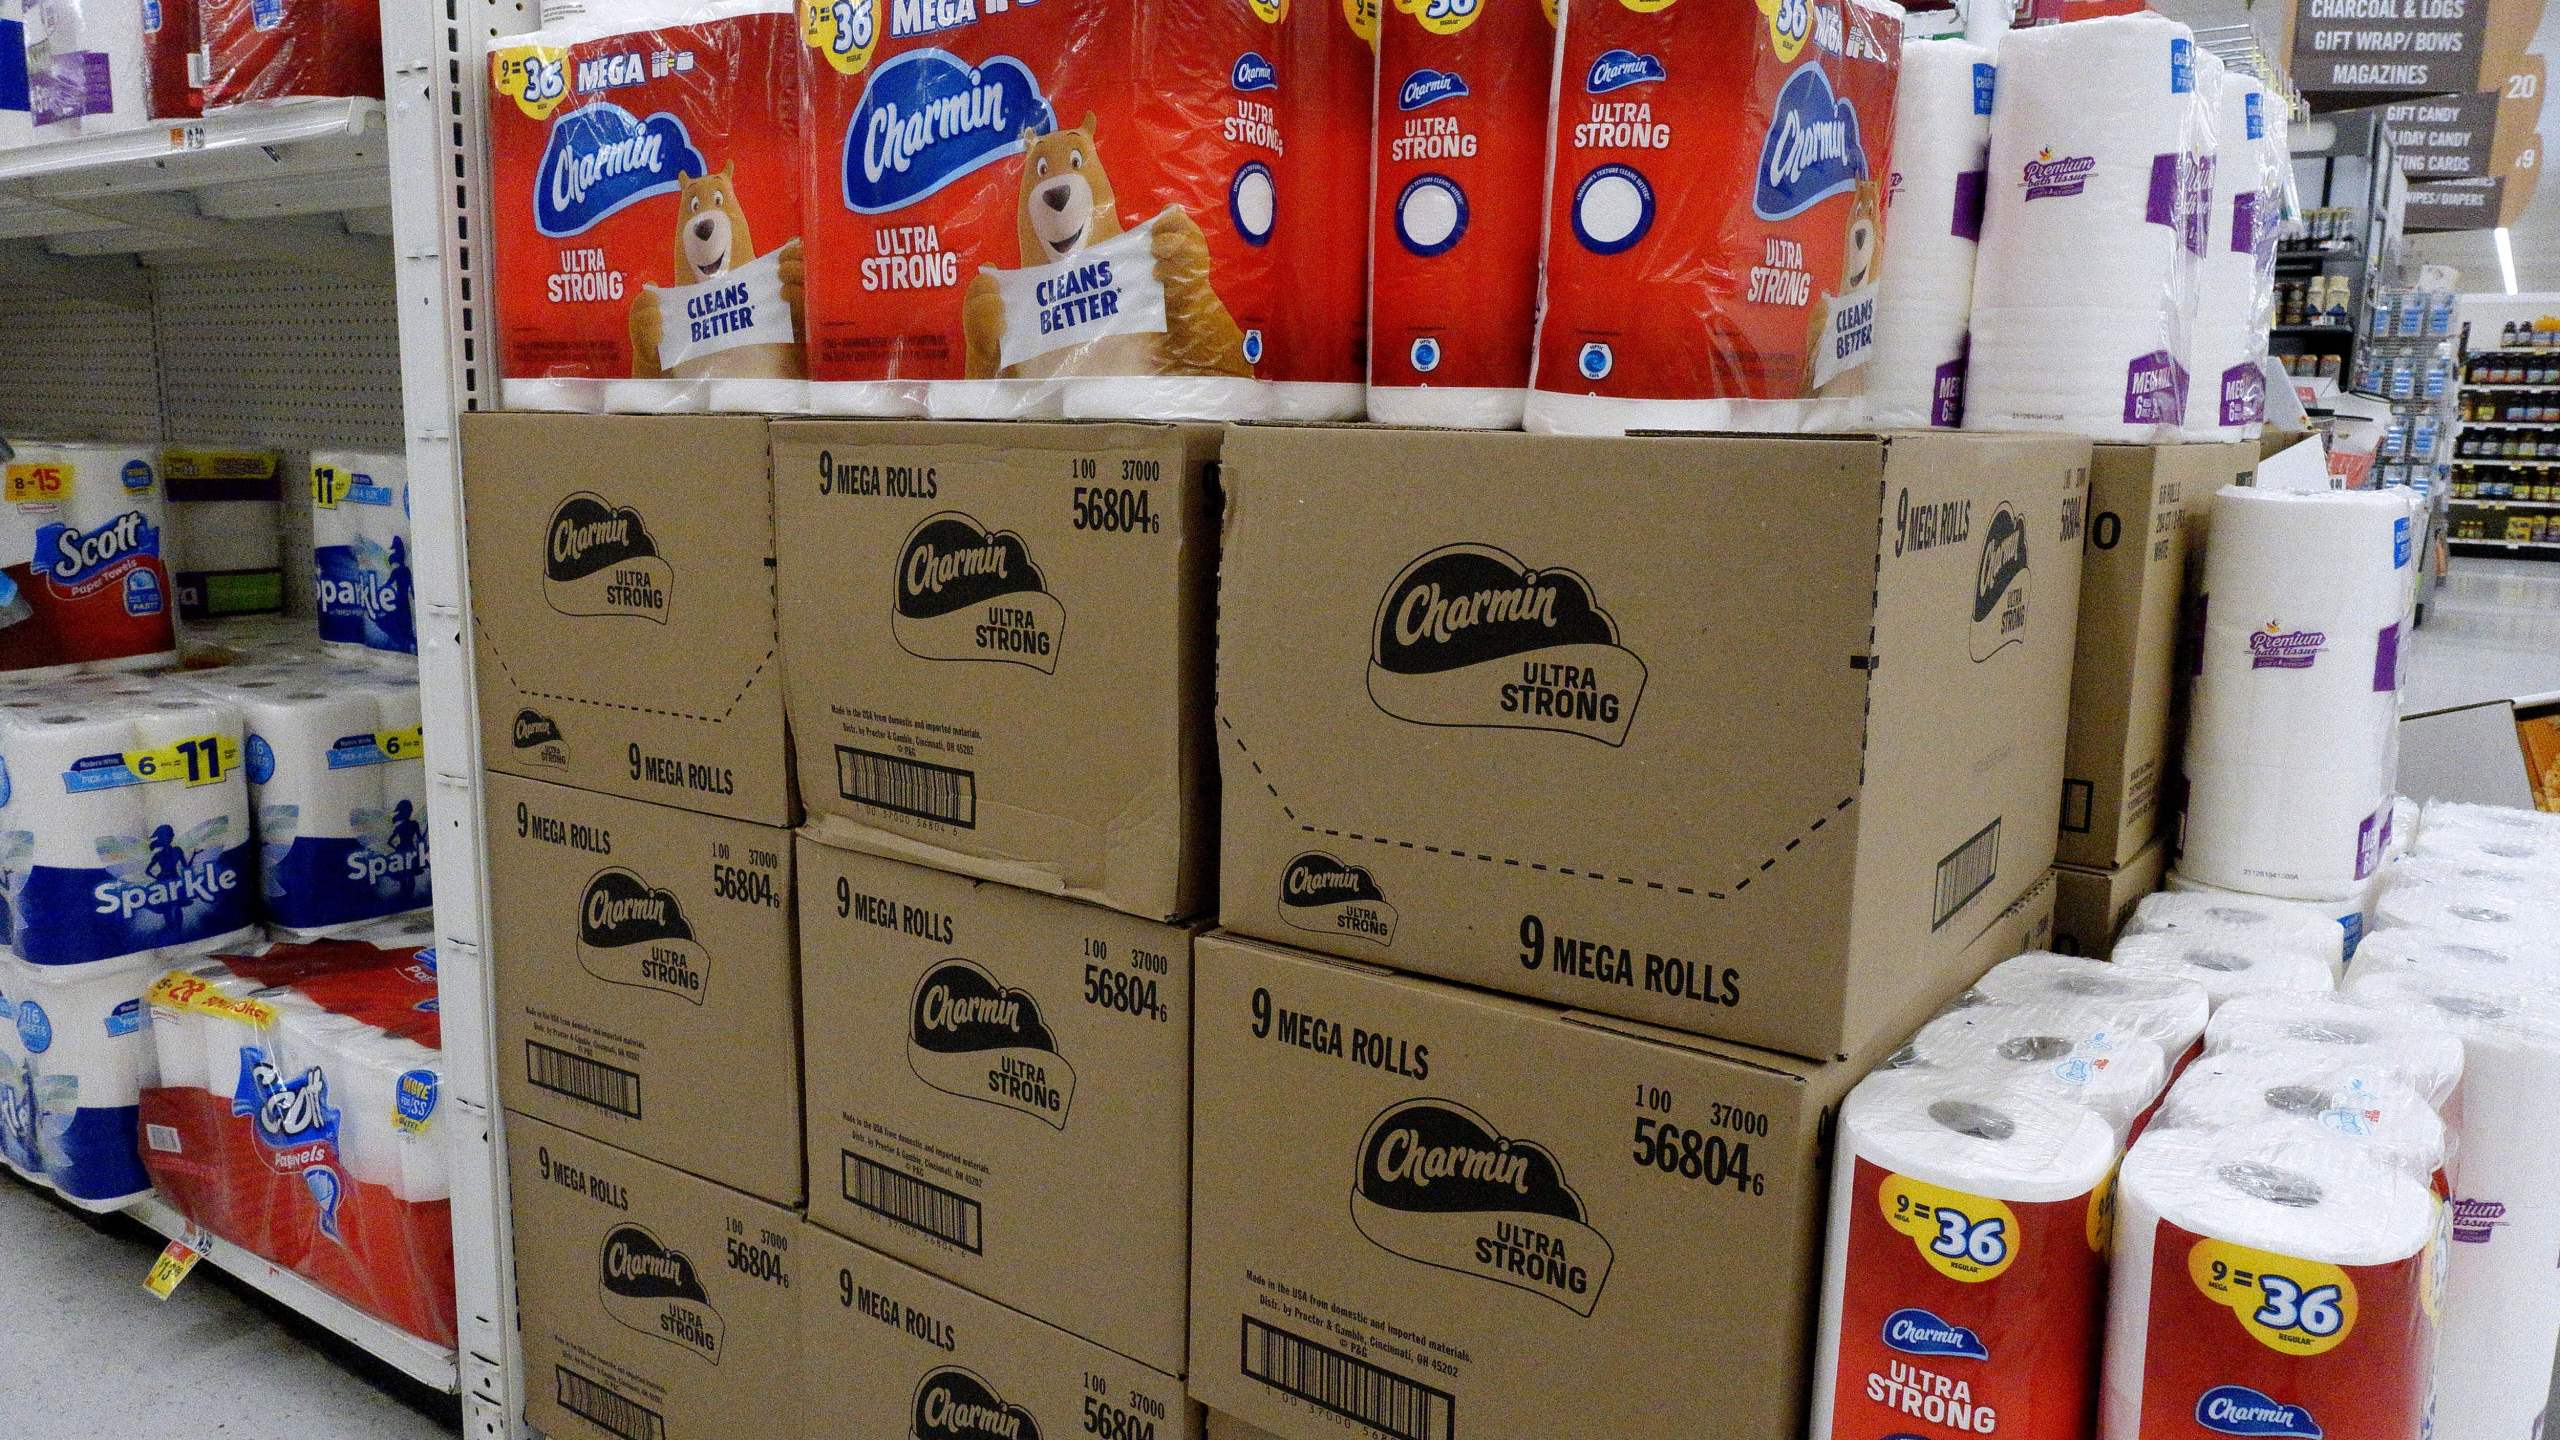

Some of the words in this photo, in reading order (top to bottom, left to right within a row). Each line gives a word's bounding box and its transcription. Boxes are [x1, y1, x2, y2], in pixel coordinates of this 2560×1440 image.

[891, 0, 978, 38] MEGA
[2311, 0, 2398, 18] CHARCOAL
[2404, 0, 2416, 18] &
[2421, 0, 2464, 19] LOGS
[1813, 5, 1843, 55] MEGA
[2315, 31, 2351, 51] GIFT
[2415, 33, 2463, 52] BOWS
[577, 53, 645, 93] MEGA
[1238, 56, 1272, 82] Charmin
[1594, 57, 1647, 85] Charmin
[2333, 65, 2429, 85] MAGAZINES
[1405, 73, 1452, 104] Charmin
[2506, 74, 2538, 99] 20
[864, 68, 1006, 184] Charmin
[1238, 100, 1274, 124] ULTRA
[1405, 117, 1459, 138] ULTRA
[1591, 102, 1652, 123] ULTRA
[2387, 106, 2416, 122] GIFT
[2418, 106, 2461, 122] CANDY
[1392, 134, 1477, 161] STRONG
[1574, 123, 1670, 150] STRONG
[1770, 102, 1848, 188] Charmin
[2428, 132, 2472, 147] CANDY
[552, 121, 663, 212] Charmin
[2026, 157, 2094, 181] Premium
[2427, 157, 2470, 171] CARDS
[875, 225, 940, 256] ULTRA
[1765, 238, 1803, 270] ULTRA
[561, 248, 605, 272] ULTRA
[861, 252, 958, 291] STRONG
[548, 271, 624, 302] STRONG
[1036, 261, 1113, 307] CLEANS
[1748, 266, 1811, 306] STRONG
[687, 282, 749, 319] CLEANS
[1835, 298, 1874, 331] CLEANS
[314, 468, 334, 504] 11
[819, 449, 833, 496] 9
[837, 465, 881, 497] MEGA
[886, 467, 938, 499] ROLLS
[1121, 459, 1160, 482] 37000
[554, 508, 629, 563] Charmin
[1895, 487, 1908, 558] 9
[1908, 504, 1938, 552] MEGA
[1940, 500, 1970, 545] ROLLS
[56, 510, 141, 577] Scott
[71, 579, 103, 596] Paper
[104, 559, 138, 581] Towels
[616, 570, 651, 588] ULTRA
[907, 533, 1008, 596] Charmin
[607, 586, 663, 609] STRONG
[1395, 573, 1557, 646] Charmin
[988, 607, 1034, 629] ULTRA
[2001, 605, 2025, 634] STRONG
[975, 625, 1051, 656] STRONG
[2253, 631, 2325, 650] Premium
[1523, 661, 1597, 691] ULTRA
[1500, 683, 1620, 724] STRONG
[138, 757, 157, 775] 6
[176, 737, 221, 782] 11
[386, 736, 401, 754] 6
[628, 742, 642, 781] 9
[645, 755, 685, 788] MEGA
[688, 762, 734, 795] ROLLS
[517, 802, 528, 838] 9
[532, 815, 567, 846] MEGA
[571, 823, 611, 855] ROLLS
[347, 842, 432, 885] Spark
[749, 849, 777, 870] 37000
[95, 862, 237, 919] Sparkle
[1289, 866, 1359, 894] Charmin
[588, 887, 665, 930] Charmin
[836, 876, 850, 918] 9
[855, 893, 898, 931] MEGA
[903, 905, 953, 945] ROLLS
[1345, 905, 1378, 922] ULTRA
[1337, 915, 1388, 937] STRONG
[652, 947, 687, 969] ULTRA
[1131, 949, 1167, 975] 37000
[1519, 914, 1545, 970] 9
[1553, 936, 1633, 987] MEGA
[1645, 951, 1741, 1008] ROLLS
[642, 959, 699, 991] STRONG
[922, 984, 1020, 1033] Charmin
[1252, 986, 1272, 1039] 9
[1279, 1009, 1343, 1060] MEGA
[1352, 1027, 1429, 1081] ROLLS
[1001, 1055, 1046, 1085] ULTRA
[988, 1070, 1060, 1113] STRONG
[1710, 1102, 1768, 1138] 37000
[1377, 1128, 1529, 1194] Charmin
[539, 1146, 550, 1180] 9
[553, 1160, 586, 1195] MEGA
[590, 1174, 629, 1211] ROLLS
[760, 1229, 788, 1251] 37000
[1496, 1220, 1566, 1262] ULTRA
[608, 1242, 681, 1286] Charmin
[1476, 1237, 1587, 1294] STRONG
[2208, 1280, 2228, 1292] MEGA
[668, 1303, 703, 1328] ULTRA
[839, 1268, 853, 1308] 9
[857, 1285, 900, 1329] MEGA
[905, 1307, 955, 1352] ROLLS
[1246, 1269, 1265, 1286] Made
[1268, 1278, 1275, 1290] in
[1278, 1283, 1290, 1295] the
[1292, 1287, 1307, 1303] USA
[1310, 1294, 1328, 1311] from
[1331, 1303, 1368, 1324] domestic
[1370, 1318, 1385, 1331] and
[1388, 1322, 1426, 1347] imported
[661, 1313, 715, 1351] STRONG
[1283, 1303, 1292, 1317] by
[1294, 1307, 1324, 1327] Procter
[1326, 1320, 1333, 1331] &
[1417, 1353, 1429, 1367] OH
[1431, 1358, 1459, 1378] 45202
[1891, 1318, 1965, 1349] Charmin
[2278, 1332, 2316, 1346] REGULAR
[1890, 1358, 1971, 1403] ULTRA
[924, 1387, 1021, 1440] Charmin
[1129, 1391, 1165, 1420] 37000
[1867, 1372, 1996, 1434] STRONG
[2207, 1397, 2294, 1427] Charmin
